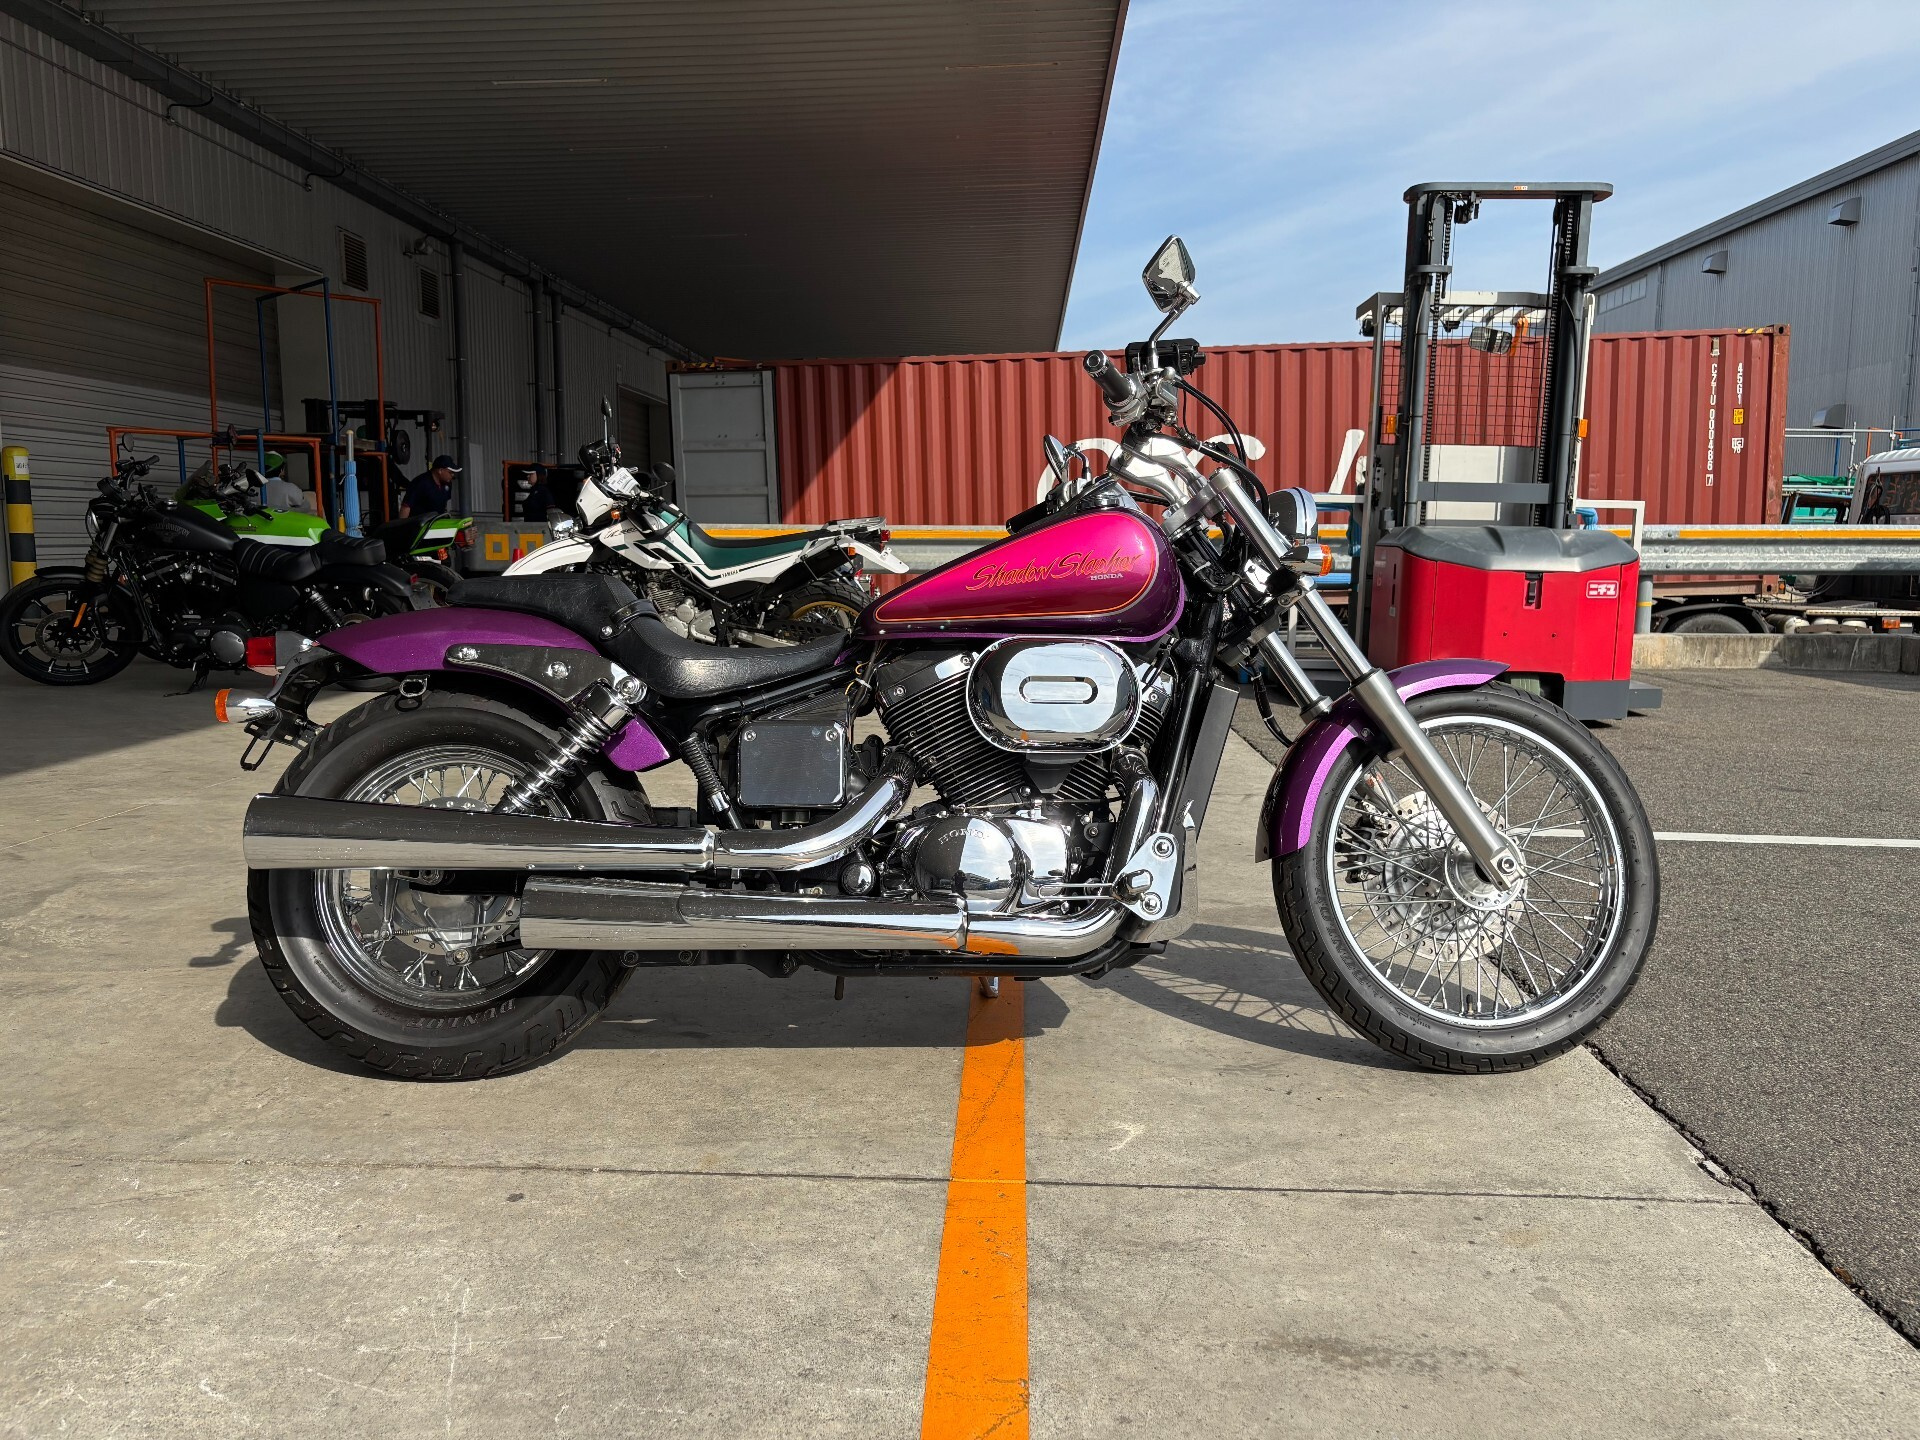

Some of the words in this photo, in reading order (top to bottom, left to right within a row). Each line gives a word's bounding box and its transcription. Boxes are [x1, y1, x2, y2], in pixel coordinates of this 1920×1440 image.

[1707, 408, 1715, 470] 000486
[1706, 474, 1713, 486] 7
[965, 557, 1059, 591] Shadow
[1051, 547, 1144, 579] Slasher
[1090, 572, 1123, 581] HONDA
